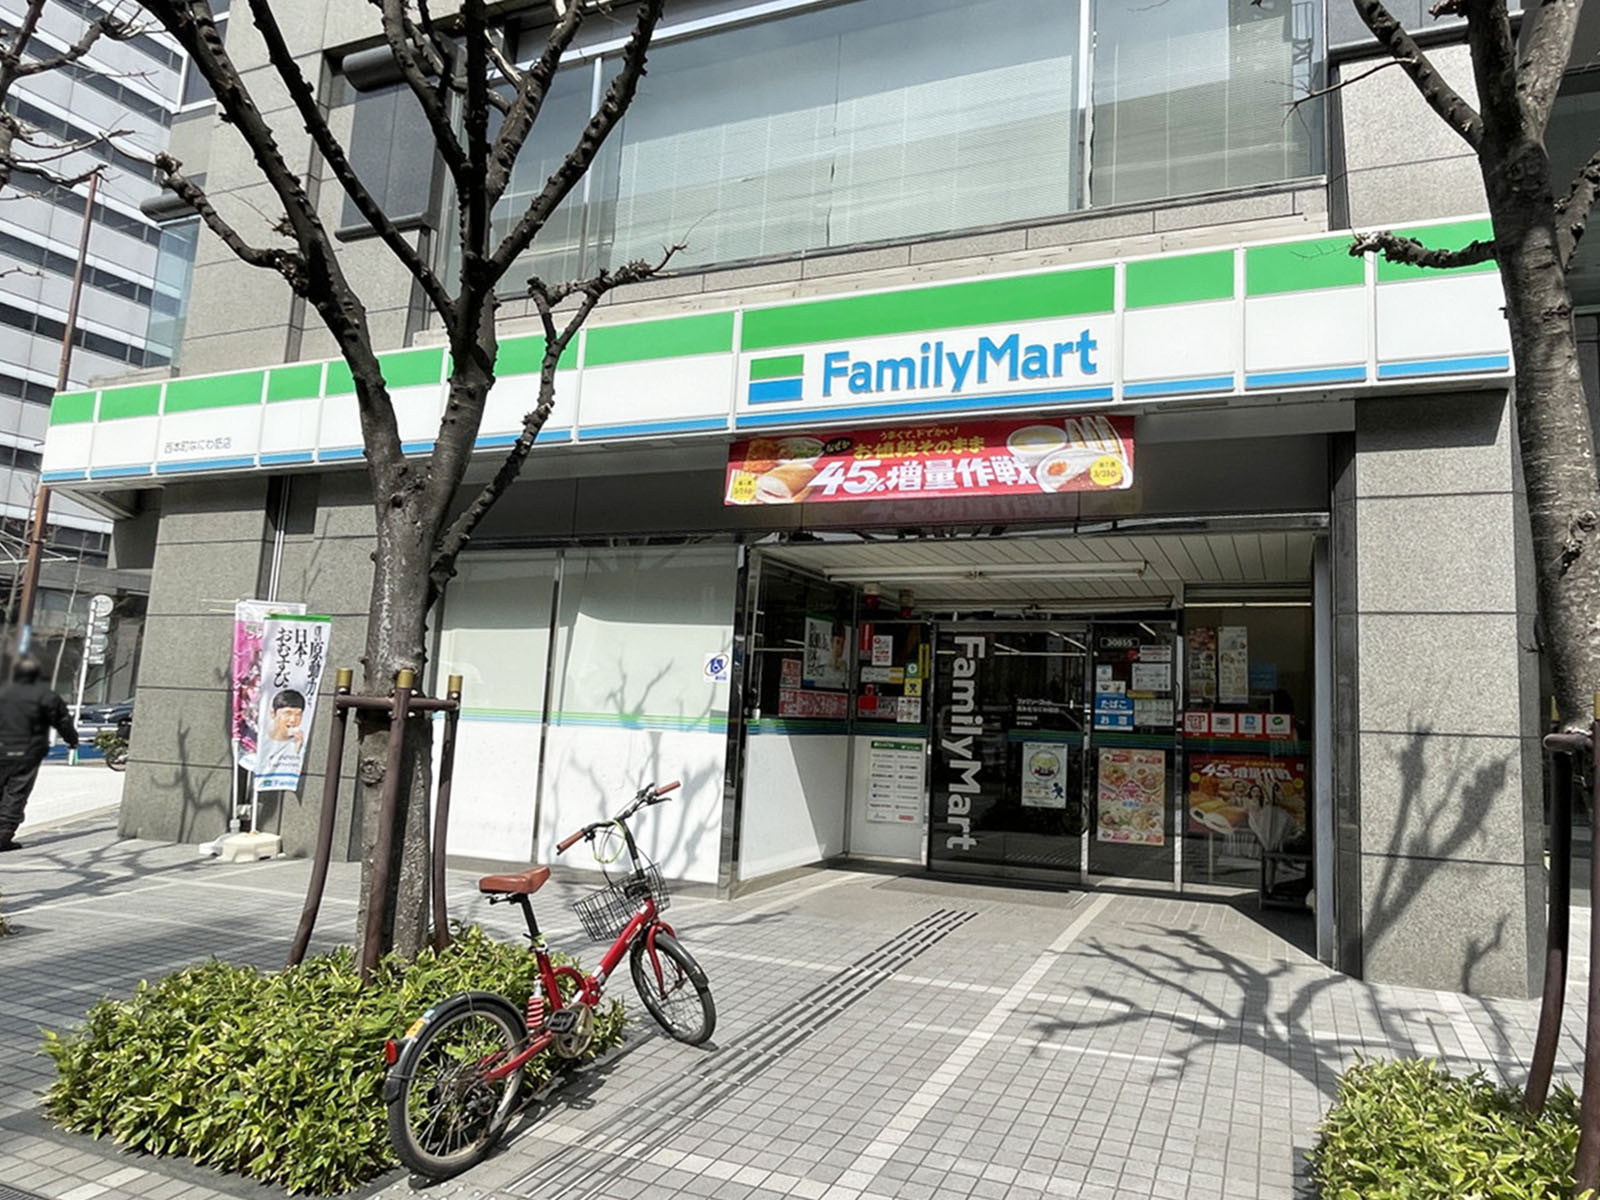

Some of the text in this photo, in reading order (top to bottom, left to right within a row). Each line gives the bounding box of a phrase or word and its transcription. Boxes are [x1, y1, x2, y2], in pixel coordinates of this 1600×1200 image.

[823, 328, 1098, 397] FamilyMart
[853, 435, 985, 460] お値段そのまま
[807, 455, 1038, 496] 45%増量作戦
[293, 628, 308, 667] 日本の
[1100, 699, 1128, 710] たばこ
[941, 636, 986, 850] FamilyMart
